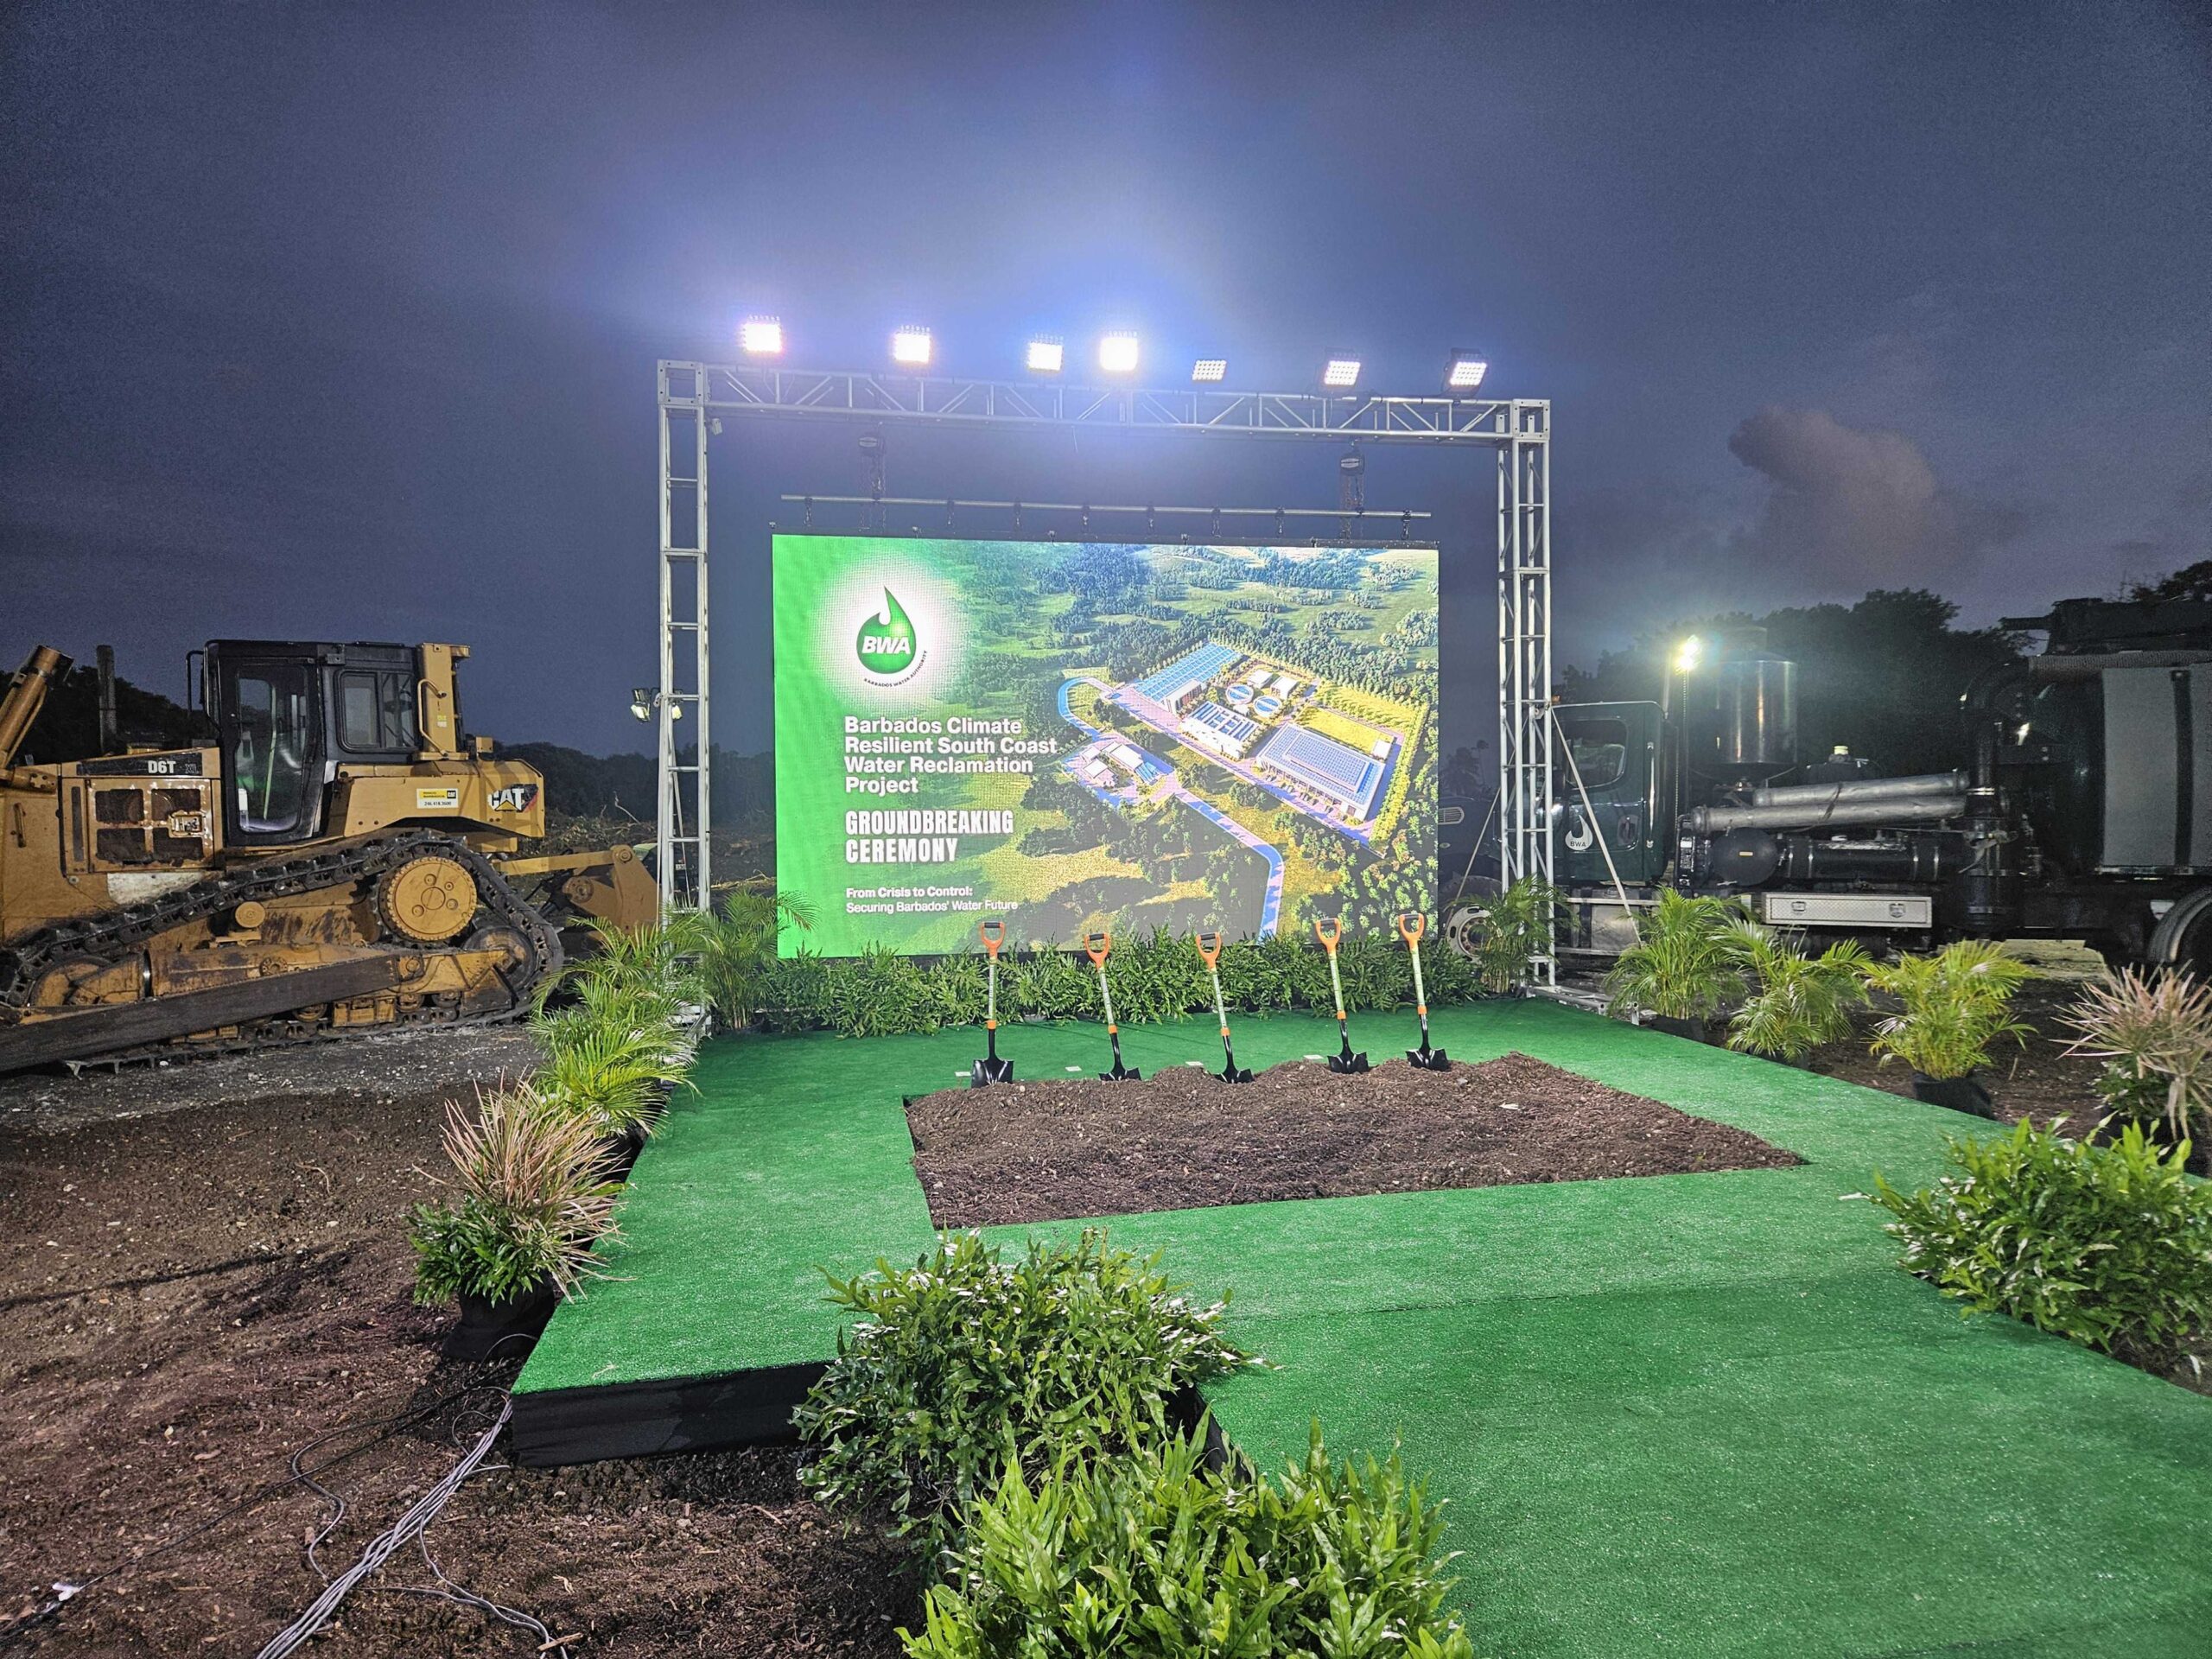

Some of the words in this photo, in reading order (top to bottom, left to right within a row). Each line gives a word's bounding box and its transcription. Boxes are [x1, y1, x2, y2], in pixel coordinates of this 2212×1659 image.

[861, 636, 911, 654] BWA
[864, 677, 893, 688] BARBADOS
[893, 677, 911, 687] WATER
[910, 650, 927, 678] AUTHORITY
[844, 716, 942, 734] Barbados
[947, 717, 1022, 734] Climate
[845, 736, 933, 753] Resilient
[938, 737, 995, 754] South
[1000, 737, 1058, 754] Coast
[148, 760, 176, 773] D6T
[844, 756, 906, 773] Water
[910, 756, 1033, 773] Reclamation
[845, 777, 918, 797] Project
[487, 788, 524, 811] CAT
[845, 810, 1014, 835] GROUNDBREAKING
[846, 838, 957, 863] CEREMONY
[846, 887, 875, 898] From
[878, 887, 911, 897] Crisis
[912, 887, 925, 897] to
[927, 886, 973, 897] Control:
[846, 902, 894, 914] Securing
[896, 901, 950, 912] Barbados'
[951, 901, 982, 912] Water
[984, 901, 1018, 911] Future
